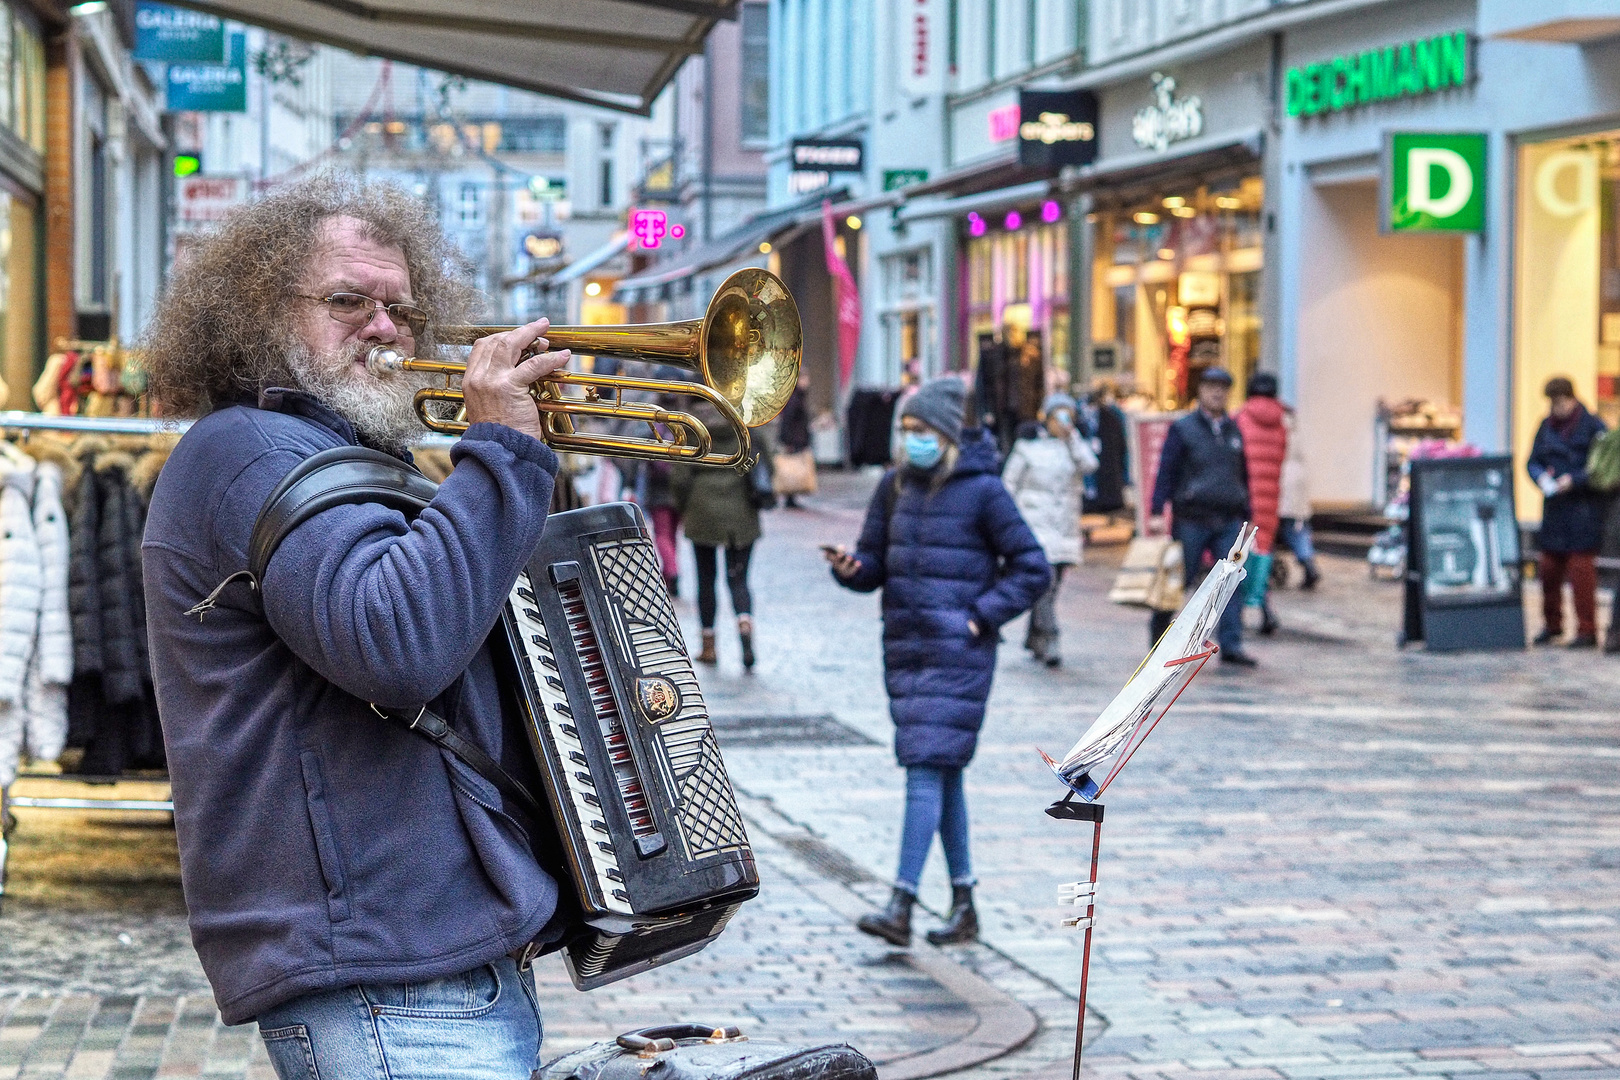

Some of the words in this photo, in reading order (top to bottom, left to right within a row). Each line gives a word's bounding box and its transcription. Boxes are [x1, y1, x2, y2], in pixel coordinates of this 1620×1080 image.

[169, 65, 242, 84] GALERIA
[1286, 30, 1467, 117] DEICHMANN
[1407, 147, 1474, 218] D
[634, 209, 667, 249] T
